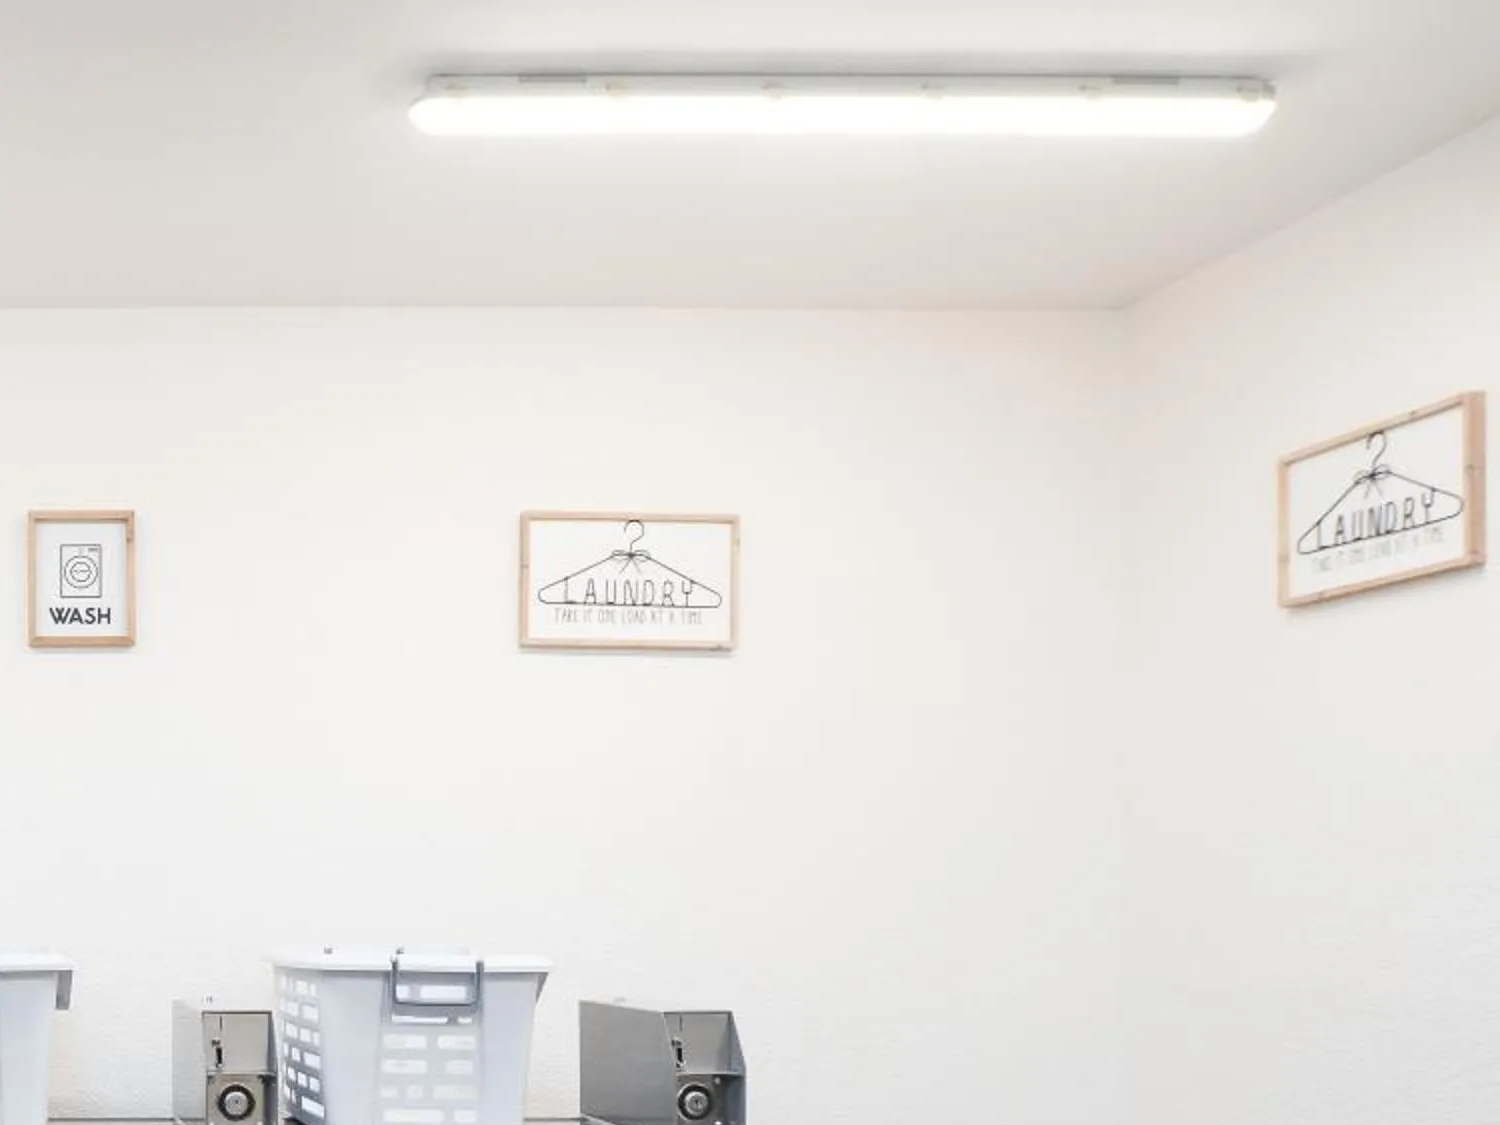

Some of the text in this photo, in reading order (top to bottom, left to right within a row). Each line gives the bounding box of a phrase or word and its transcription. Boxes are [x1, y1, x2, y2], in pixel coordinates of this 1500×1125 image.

[1316, 487, 1436, 550] LAUNDRY
[564, 576, 693, 608] LAUNDRY
[49, 607, 111, 624] WASH
